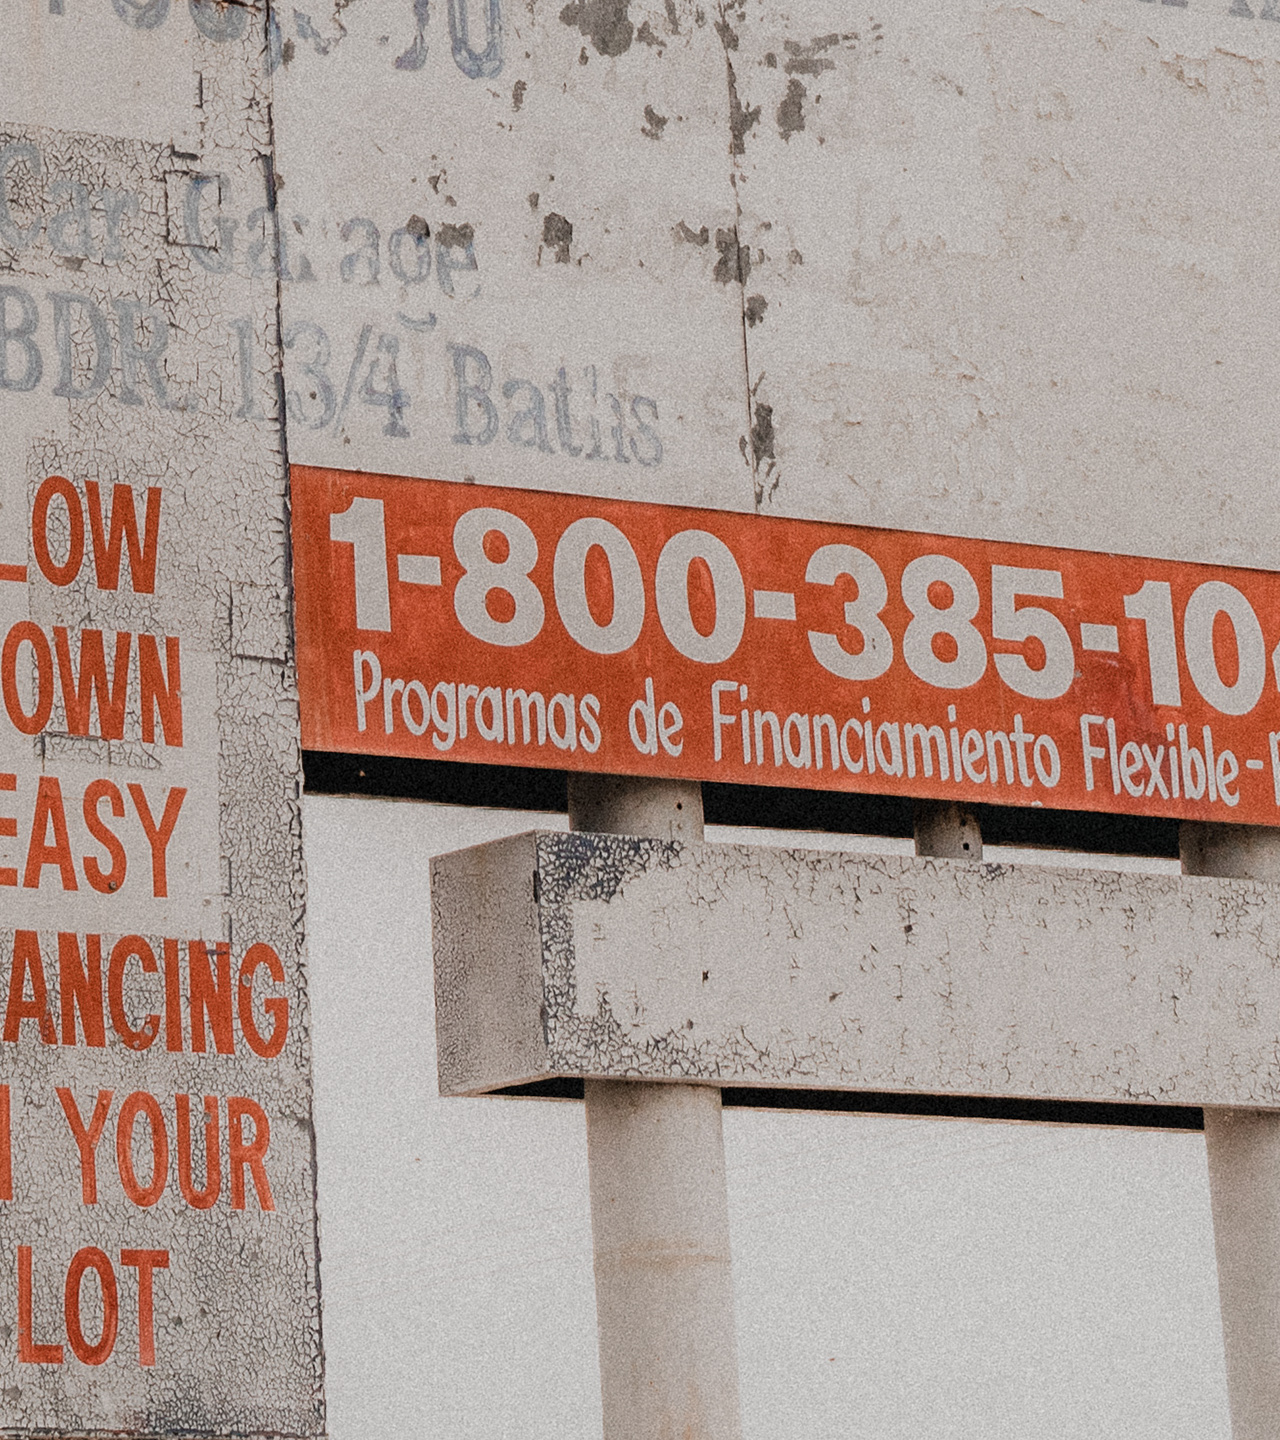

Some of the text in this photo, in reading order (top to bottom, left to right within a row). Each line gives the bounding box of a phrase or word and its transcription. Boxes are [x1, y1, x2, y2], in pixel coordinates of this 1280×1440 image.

[352, 649, 602, 754] Programas
[627, 676, 685, 758] de
[711, 679, 1062, 790] Financiamiento
[56, 1088, 276, 1212] YOUR
[17, 1246, 170, 1366] LOT
